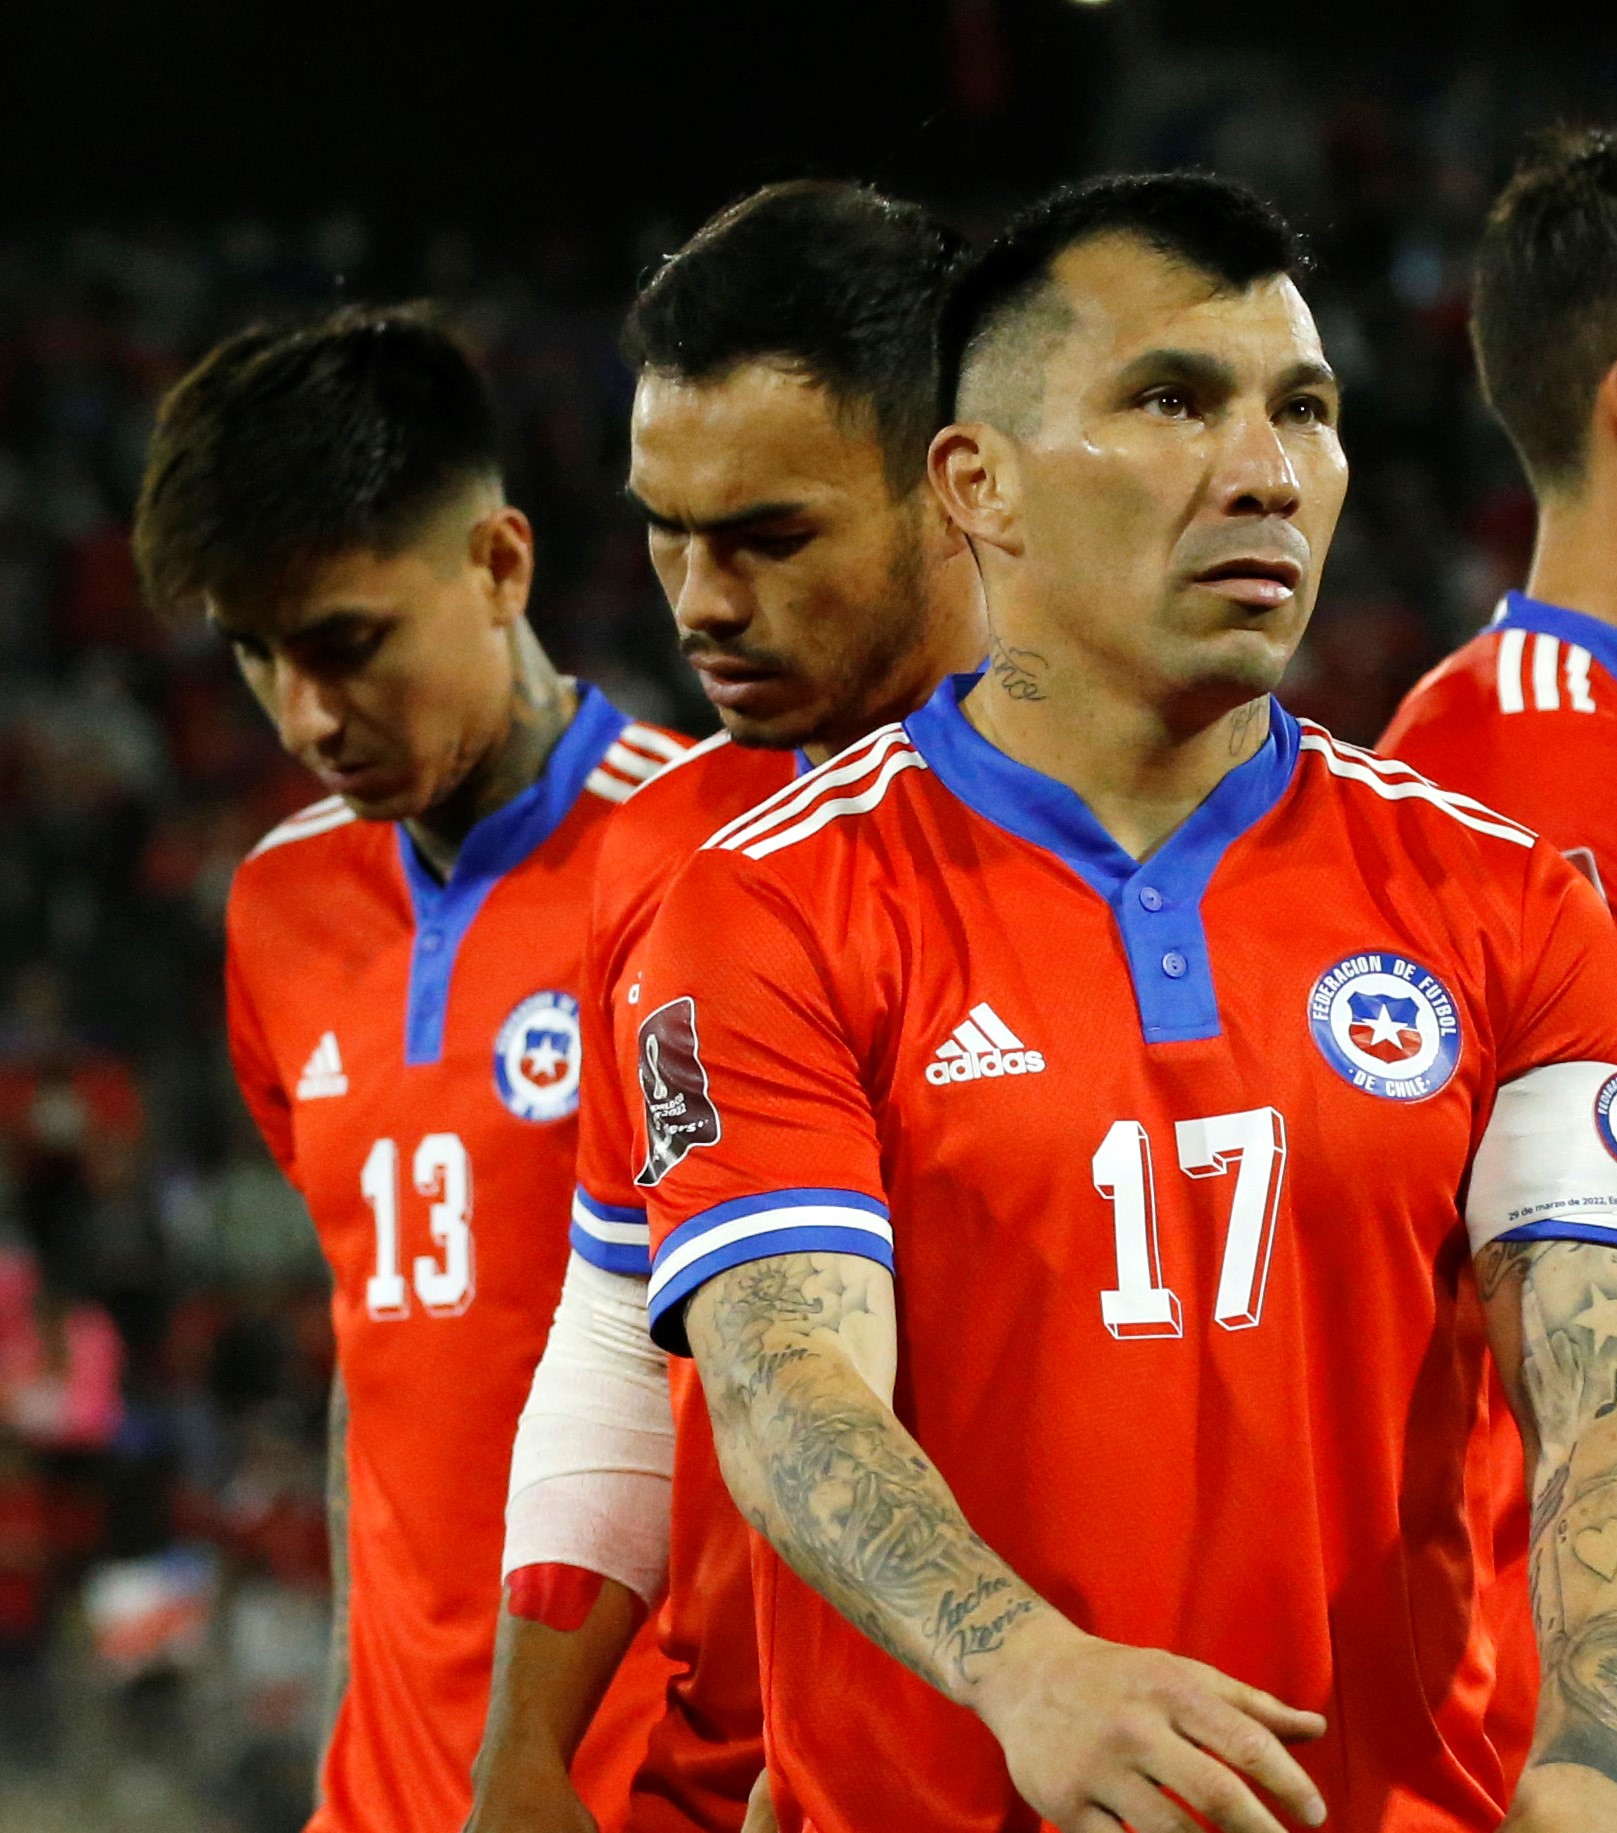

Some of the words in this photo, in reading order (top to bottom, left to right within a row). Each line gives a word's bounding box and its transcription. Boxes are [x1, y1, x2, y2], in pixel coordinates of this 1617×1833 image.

[1313, 955, 1382, 1021] FEDERACION
[1393, 959, 1417, 981] DE
[1418, 976, 1457, 1037] FUTBOL
[926, 1048, 1046, 1086] adidas
[1353, 1070, 1376, 1091] DE
[1385, 1076, 1427, 1098] CHILE
[361, 1132, 474, 1321] 13
[1092, 1105, 1288, 1340] 17
[1508, 1210, 1520, 1221] 29
[1521, 1206, 1534, 1216] de
[1535, 1201, 1566, 1212] marzo
[1567, 1198, 1580, 1207] de
